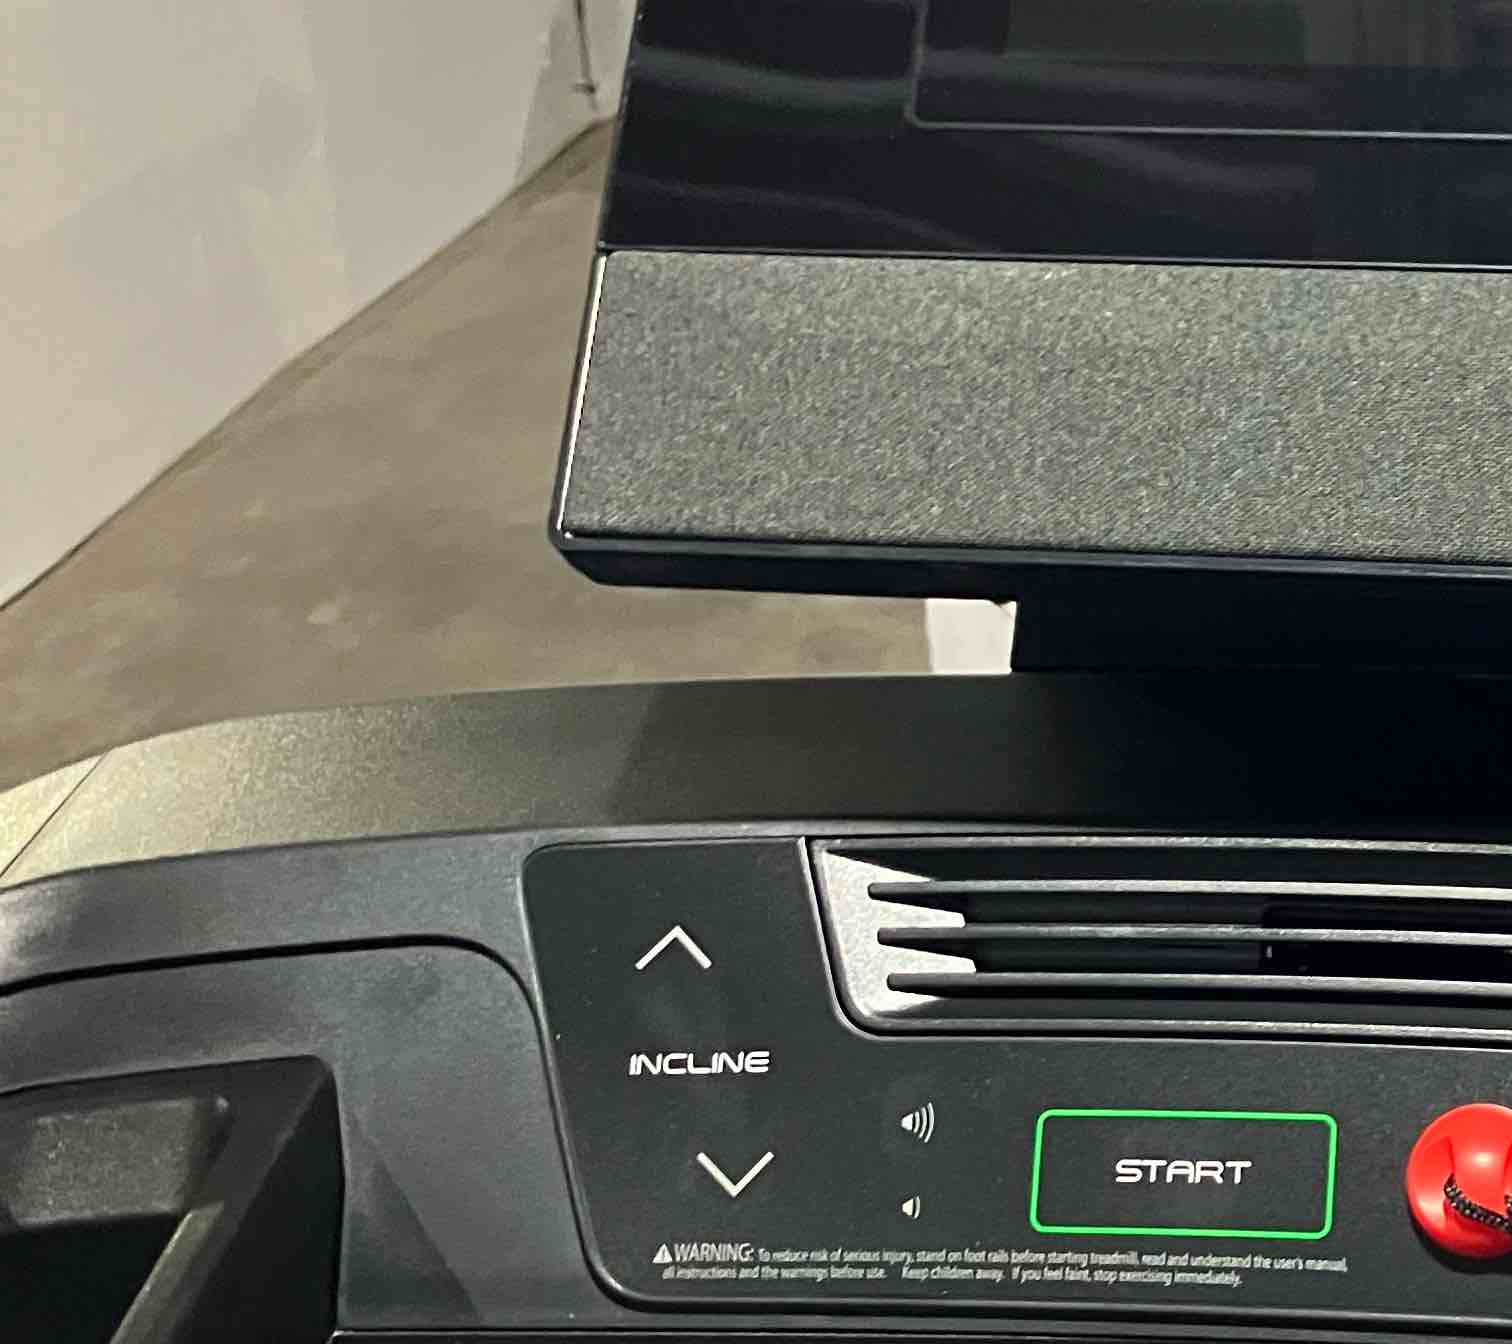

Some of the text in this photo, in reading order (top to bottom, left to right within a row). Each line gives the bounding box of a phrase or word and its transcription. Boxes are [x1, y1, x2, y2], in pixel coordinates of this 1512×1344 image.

[629, 1050, 770, 1076] INCLINE
[1115, 1158, 1252, 1185] START
[674, 1242, 753, 1263] WARNING:
[915, 1249, 945, 1263] stand
[1011, 1249, 1048, 1265] before
[1048, 1250, 1089, 1267] starting
[1253, 1255, 1271, 1269] the
